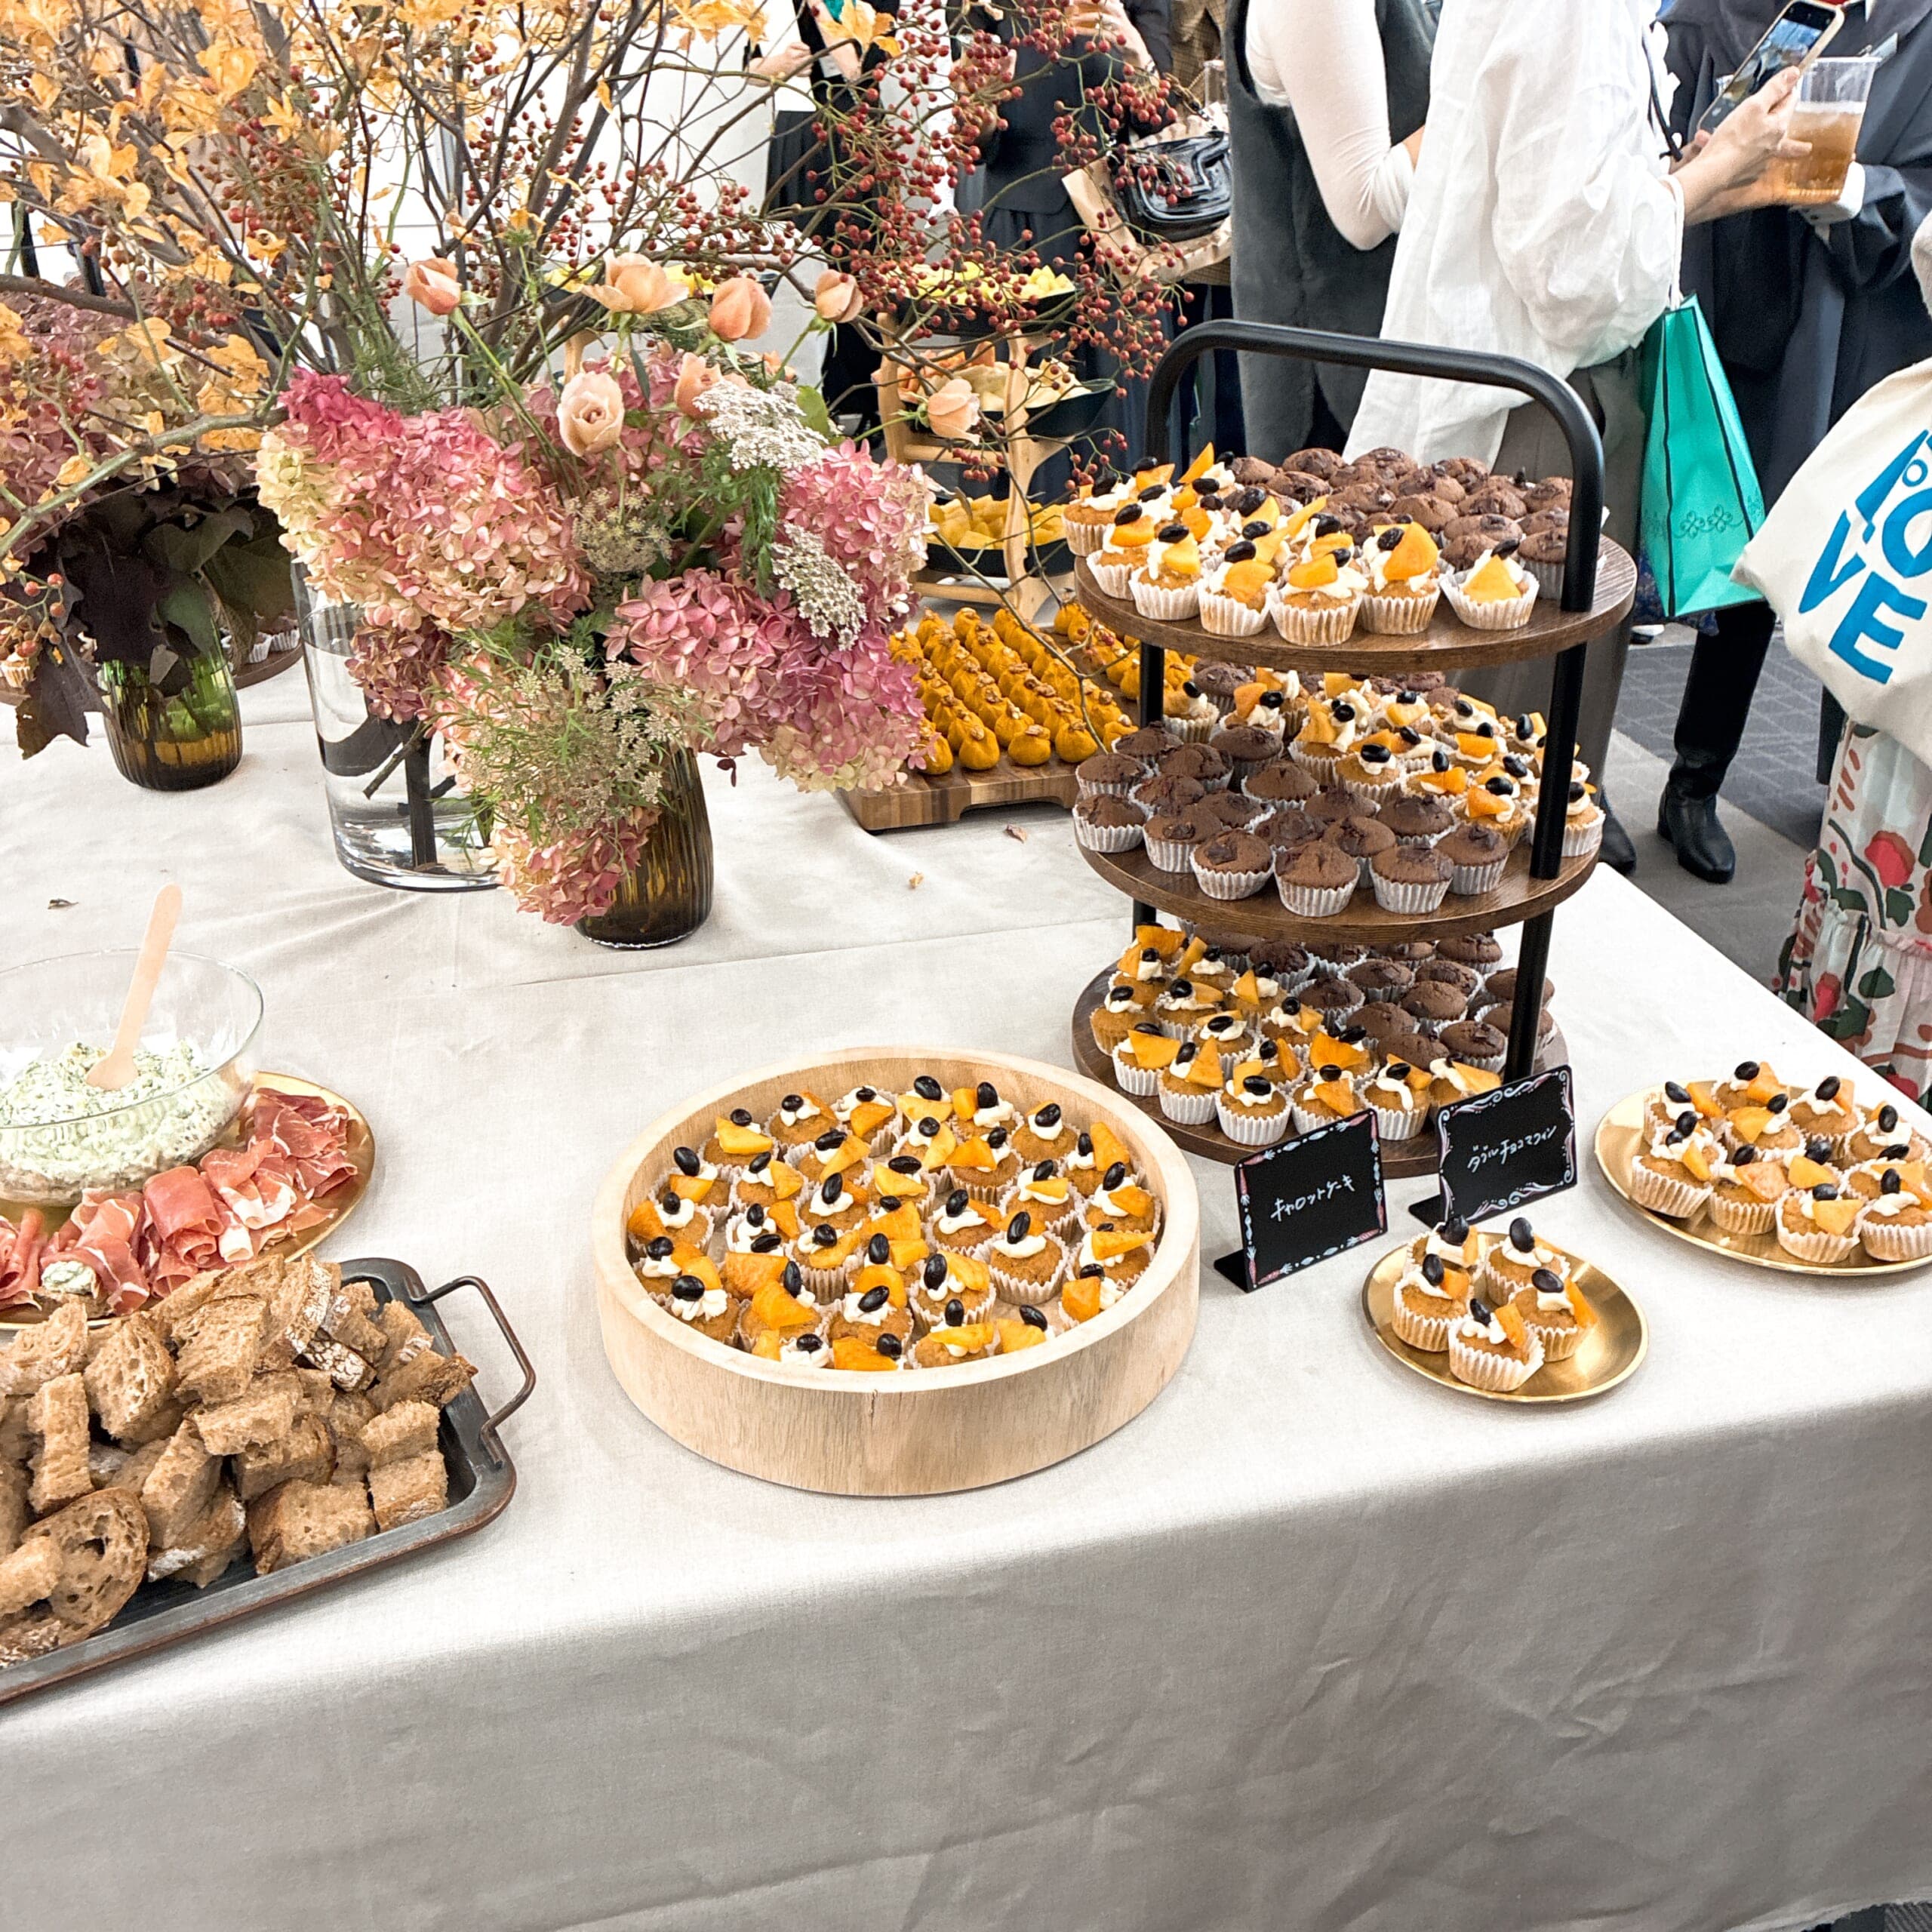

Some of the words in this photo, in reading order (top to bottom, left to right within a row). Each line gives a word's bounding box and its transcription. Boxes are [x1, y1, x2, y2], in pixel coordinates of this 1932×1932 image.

[1466, 1124, 1557, 1174] ダブルチョコマフィン
[1270, 1174, 1355, 1223] キャロットケーキ
